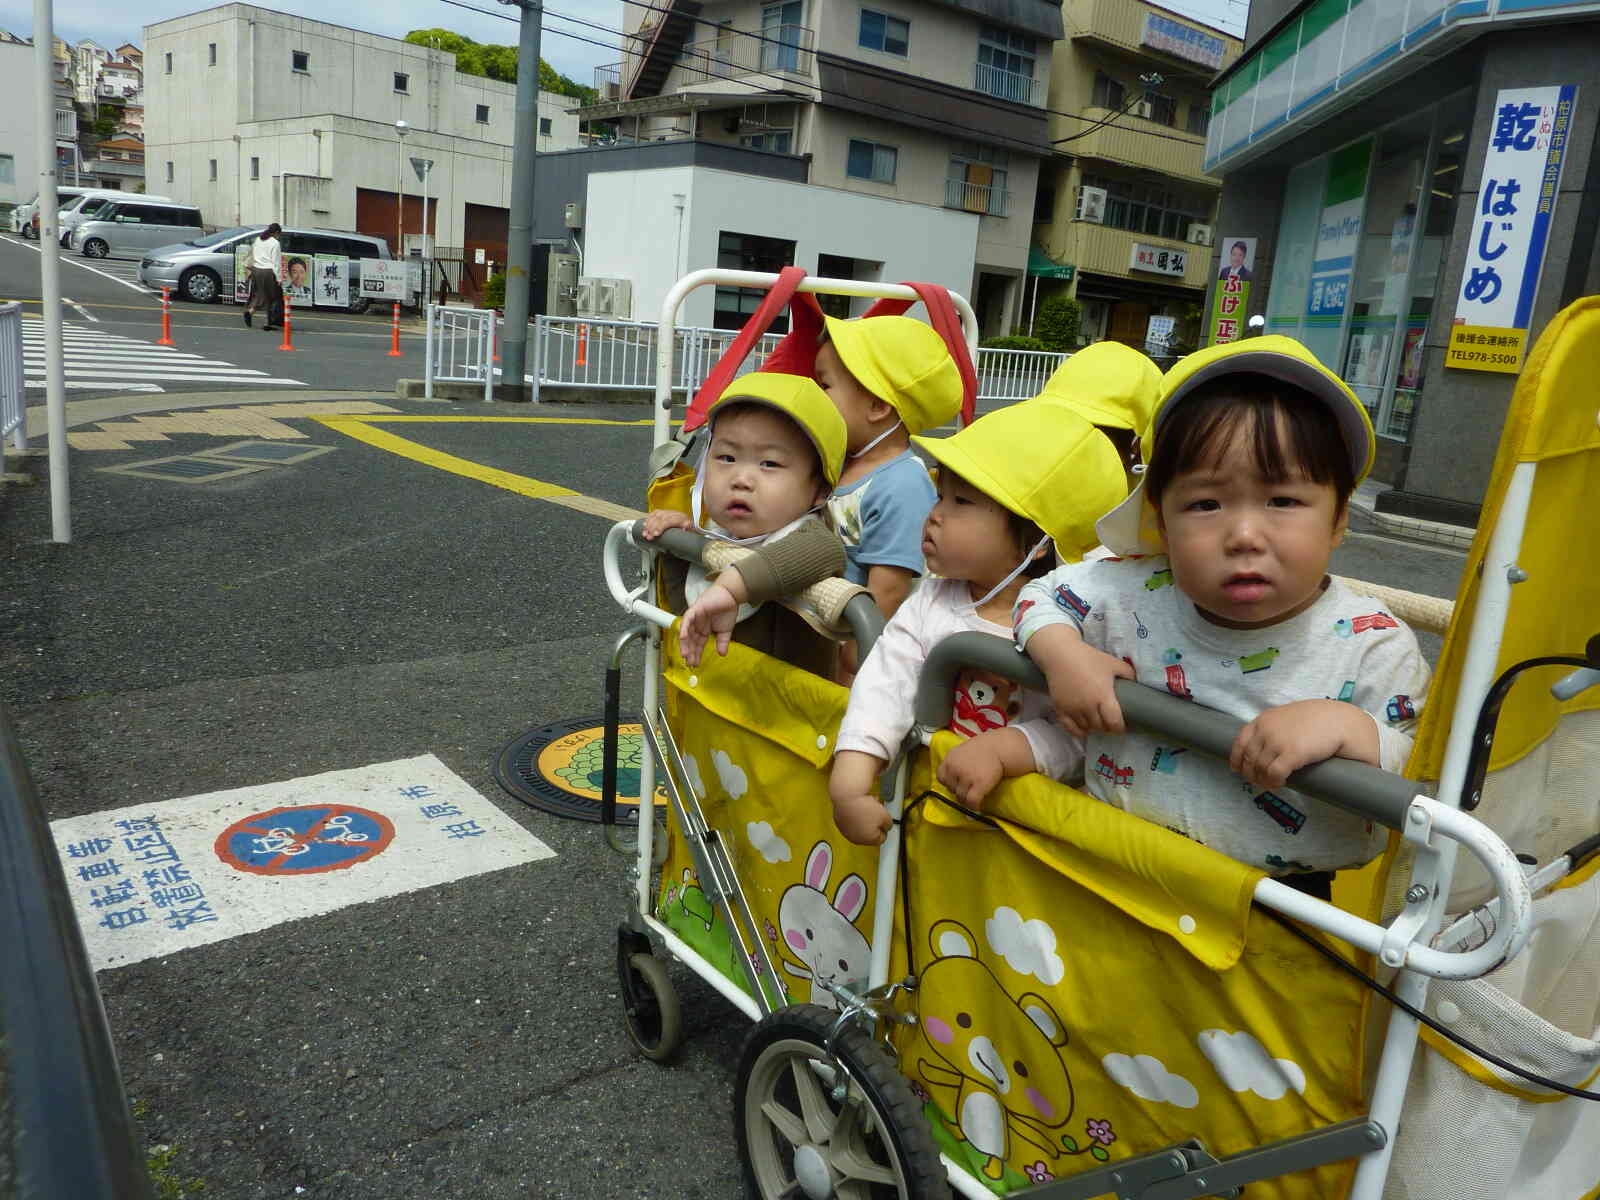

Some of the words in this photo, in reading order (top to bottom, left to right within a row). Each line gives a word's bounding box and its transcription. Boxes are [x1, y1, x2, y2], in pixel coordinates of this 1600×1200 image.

[1492, 102, 1541, 152] 乾
[1537, 105, 1555, 150] いぬい
[1463, 179, 1520, 304] はじめ
[323, 261, 341, 300] 維新
[376, 282, 384, 292] P
[1215, 274, 1243, 344] ふけ正
[397, 785, 487, 841] 柏原市
[67, 838, 151, 930] 自転車等
[115, 815, 219, 931] 放置禁止区域
